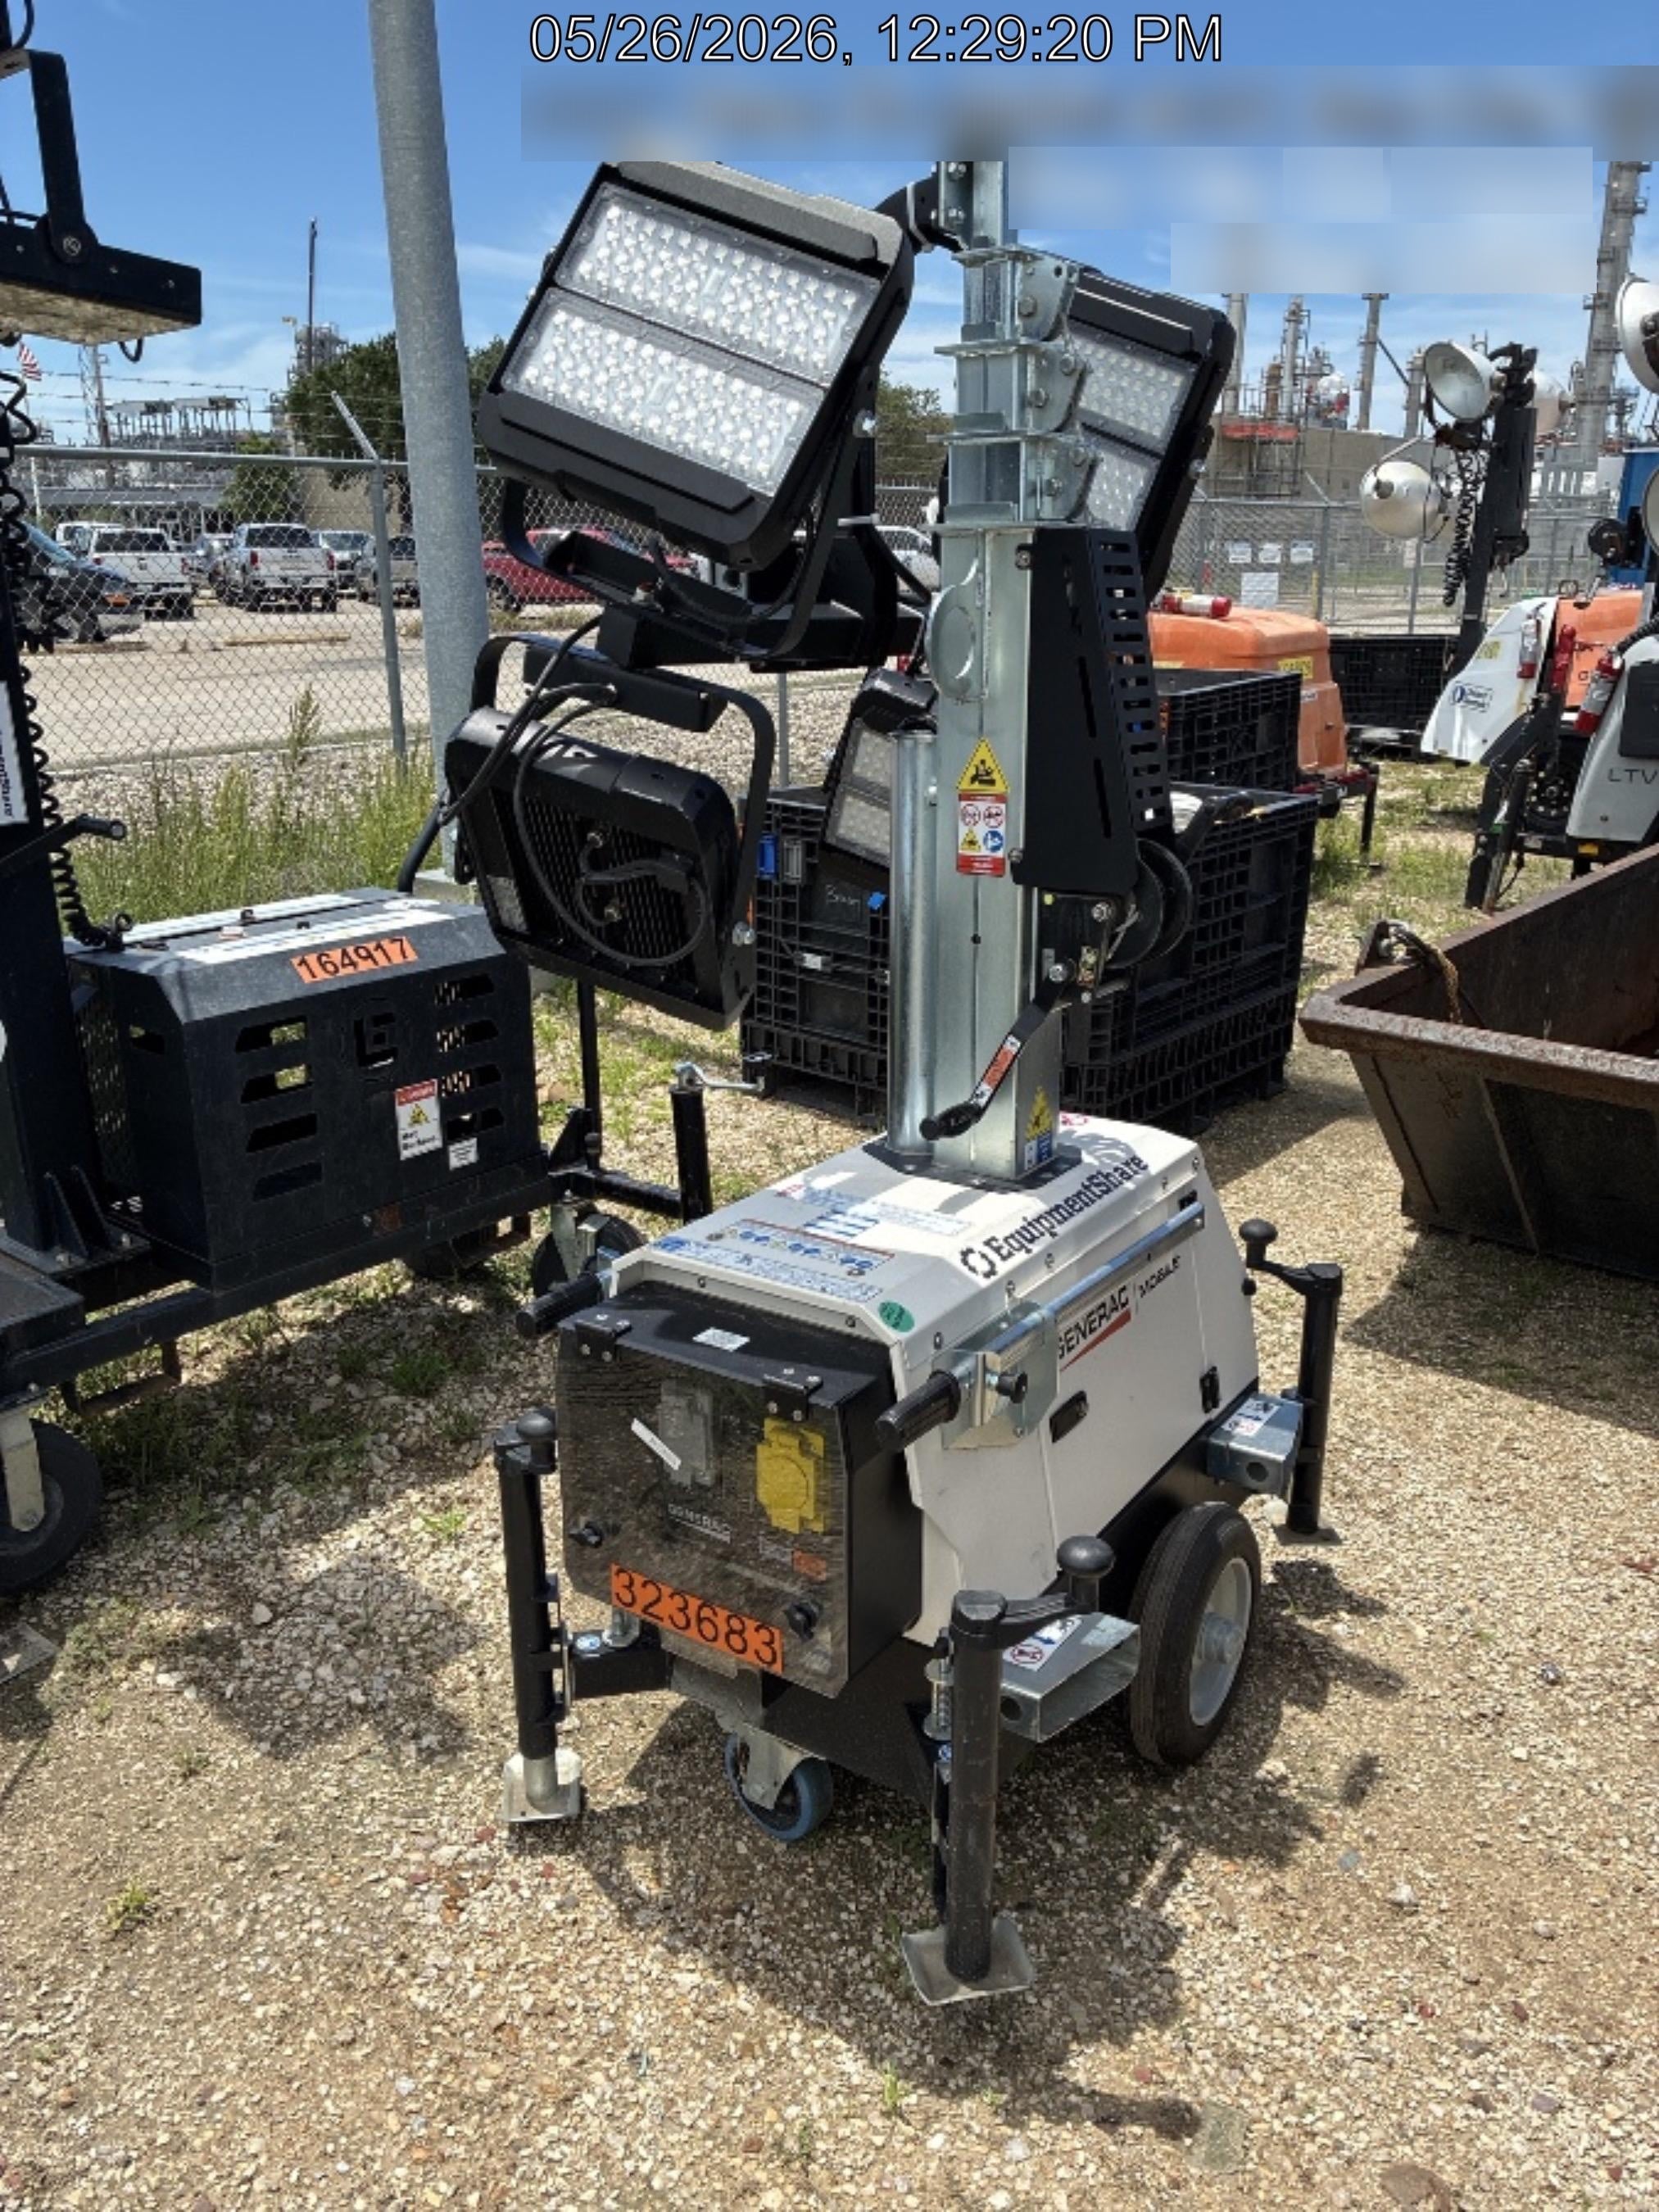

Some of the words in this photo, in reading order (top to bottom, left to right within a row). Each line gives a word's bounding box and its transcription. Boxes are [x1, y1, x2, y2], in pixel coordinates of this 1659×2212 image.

[297, 937, 409, 979] 164917
[983, 1154, 1149, 1262] EquipmentShare
[614, 1568, 778, 1666] 323683
